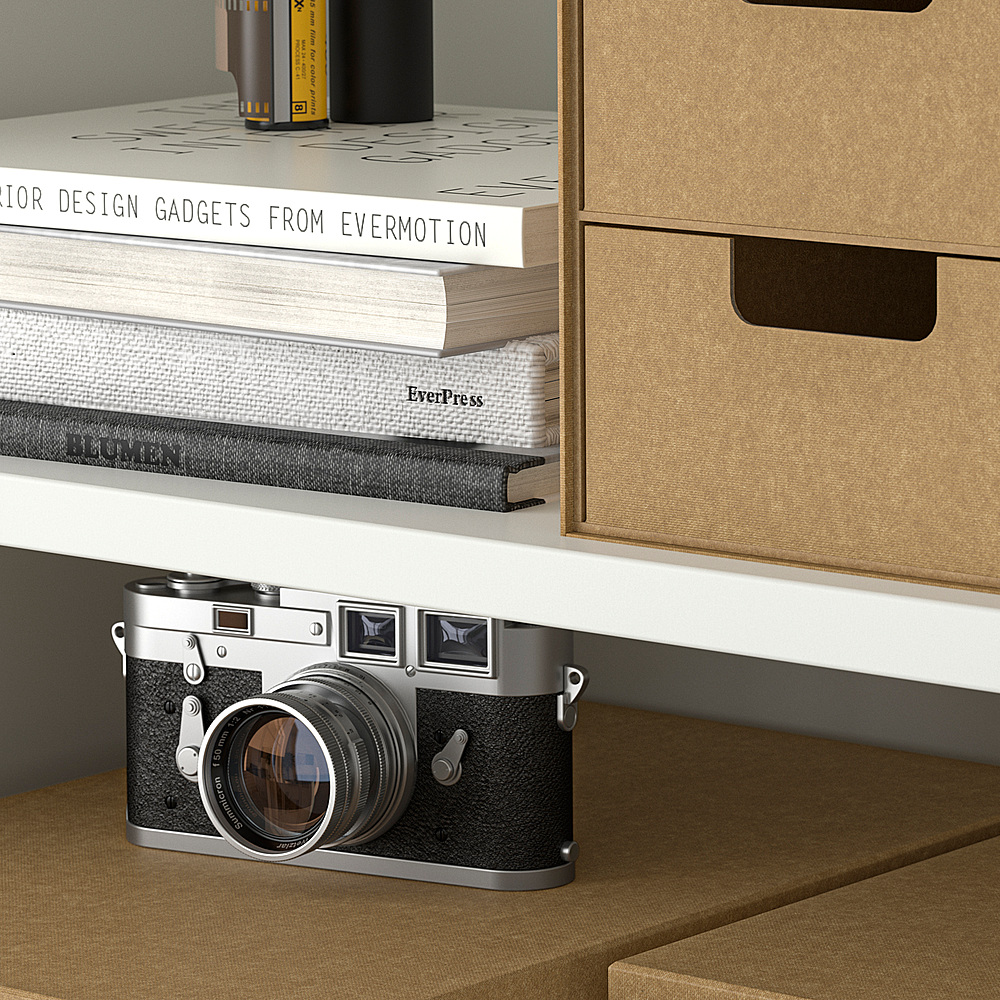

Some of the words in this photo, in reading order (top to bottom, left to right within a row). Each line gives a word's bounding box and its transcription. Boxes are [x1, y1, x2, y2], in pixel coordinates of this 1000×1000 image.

[310, 10, 316, 26] mm
[294, 104, 304, 112] 8
[309, 89, 317, 115] prints
[361, 131, 558, 164] GADGE
[0, 184, 44, 211] IOR
[59, 188, 139, 219] DESIGN
[155, 196, 251, 228] GADGETS
[269, 205, 324, 234] FROM
[341, 211, 486, 248] EVERMOTION
[406, 385, 484, 408] EverPress
[65, 433, 183, 468] BLUMEN
[217, 730, 229, 747] mm
[213, 749, 222, 761] 50
[214, 776, 243, 830] Summicron
